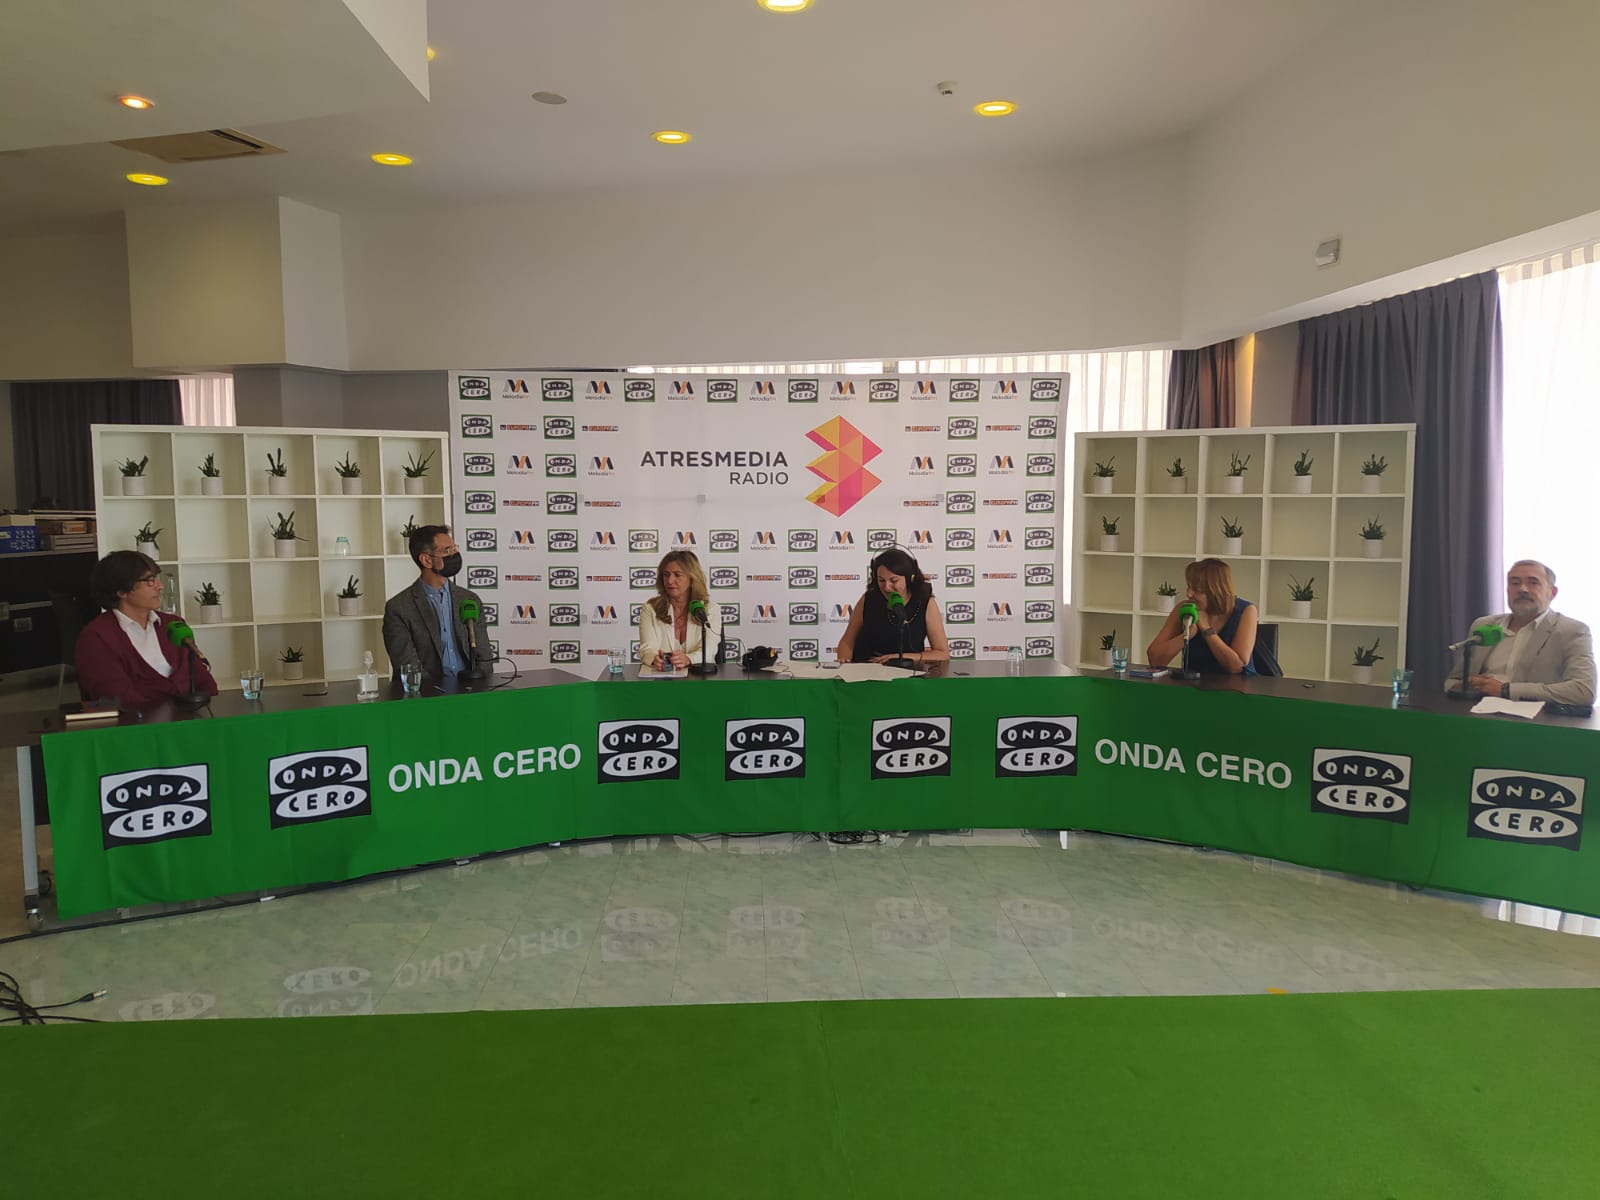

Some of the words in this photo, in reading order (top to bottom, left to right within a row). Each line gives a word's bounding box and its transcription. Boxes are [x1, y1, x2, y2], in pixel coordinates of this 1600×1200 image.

[640, 451, 788, 467] ATRESMEDIA
[729, 471, 789, 485] RADIO
[609, 732, 667, 746] ONDA
[735, 730, 793, 745] ONDA
[882, 728, 940, 744] ONDA
[1007, 728, 1066, 741] ONDA
[612, 755, 668, 771] CERO
[740, 753, 794, 769] CERO
[885, 752, 940, 768] CERO
[1010, 751, 1066, 766] CERO
[1094, 737, 1186, 774] ONDA
[1195, 751, 1293, 790] CERO
[283, 763, 354, 784] ONDA
[388, 755, 483, 793] ONDA
[492, 743, 581, 779] CERO
[1325, 761, 1396, 781] ONDA
[115, 782, 193, 803] ONDA
[288, 790, 355, 812] CERO
[1328, 788, 1395, 809] CERO
[1485, 782, 1566, 805] ONDA
[123, 810, 194, 833] CERO
[1488, 811, 1564, 834] CERO
